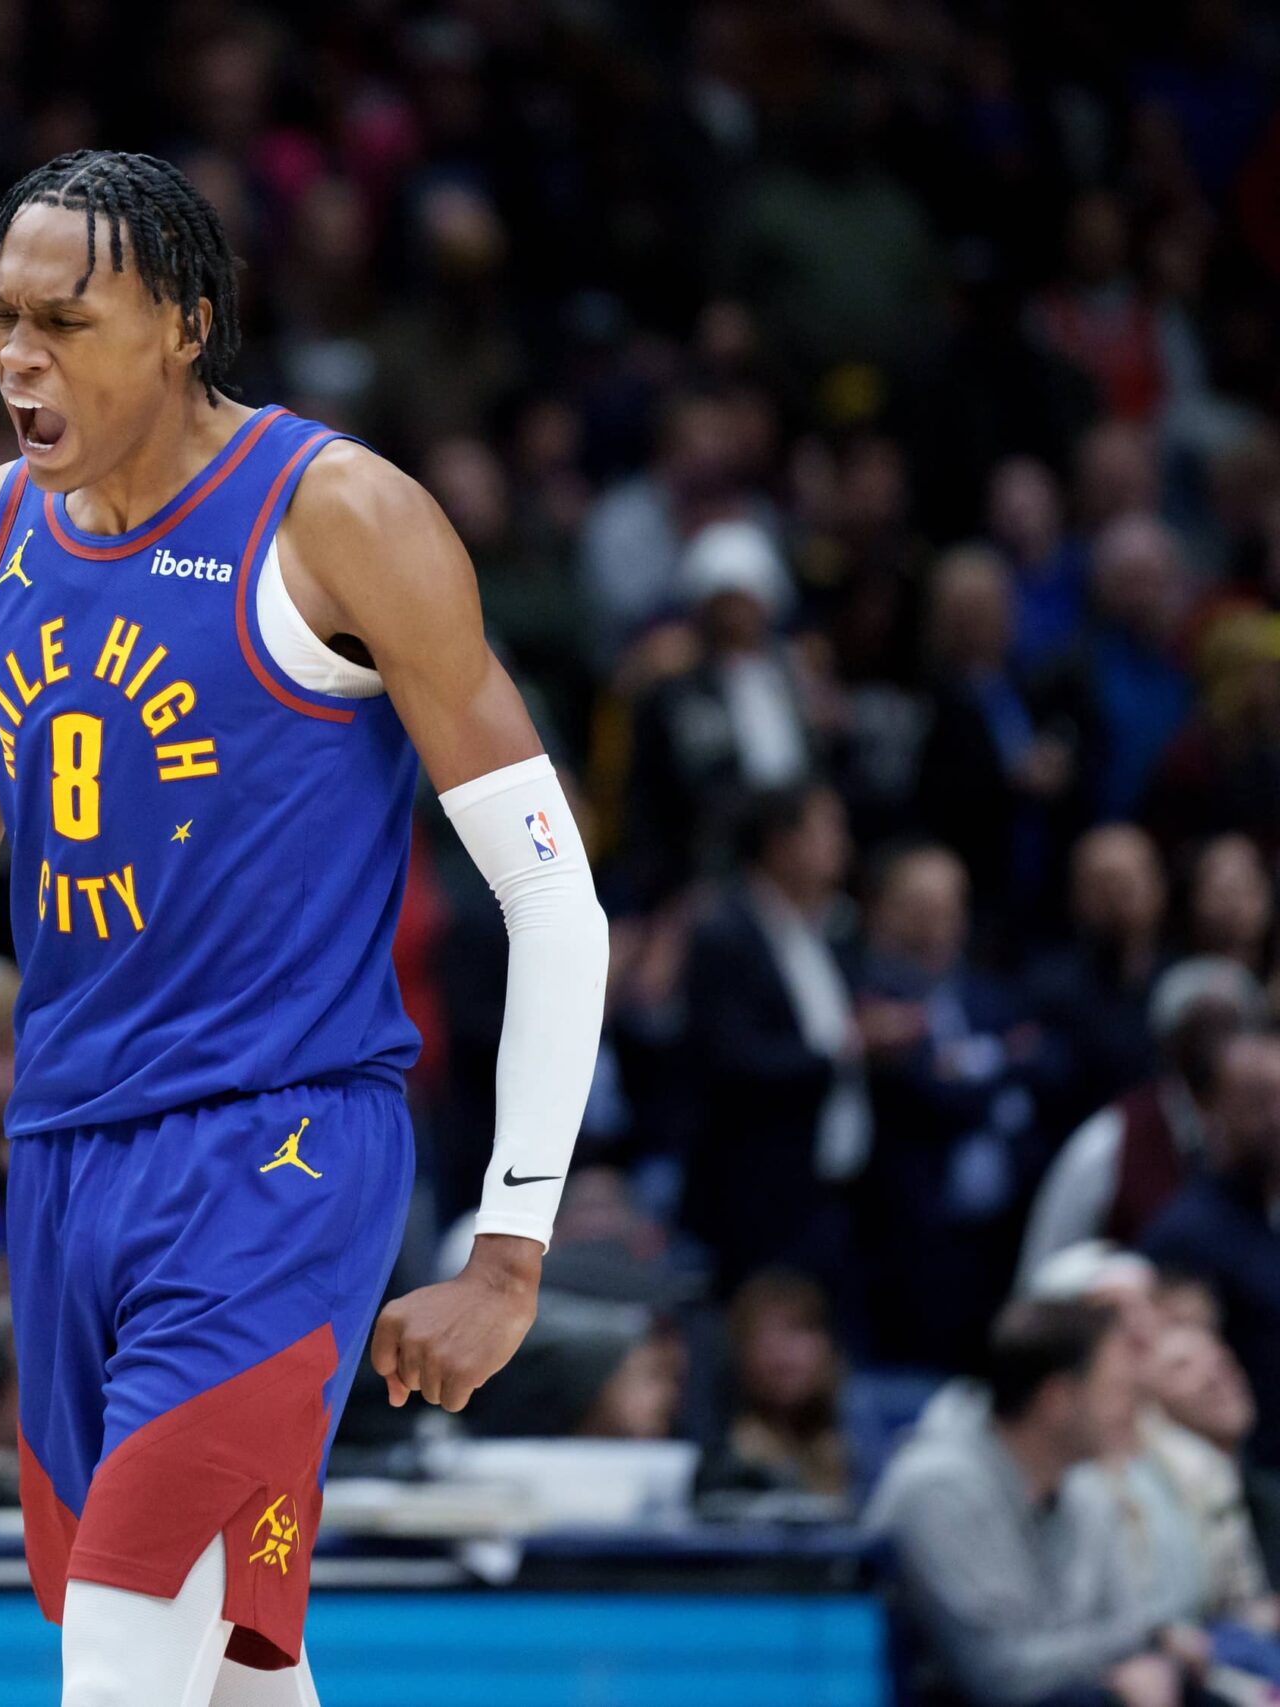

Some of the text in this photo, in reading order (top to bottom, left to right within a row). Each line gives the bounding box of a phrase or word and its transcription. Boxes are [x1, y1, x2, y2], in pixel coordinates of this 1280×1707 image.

[151, 549, 233, 583] ibotta
[94, 615, 219, 782] HIGH
[51, 711, 104, 841] 8
[38, 859, 146, 940] CITY
